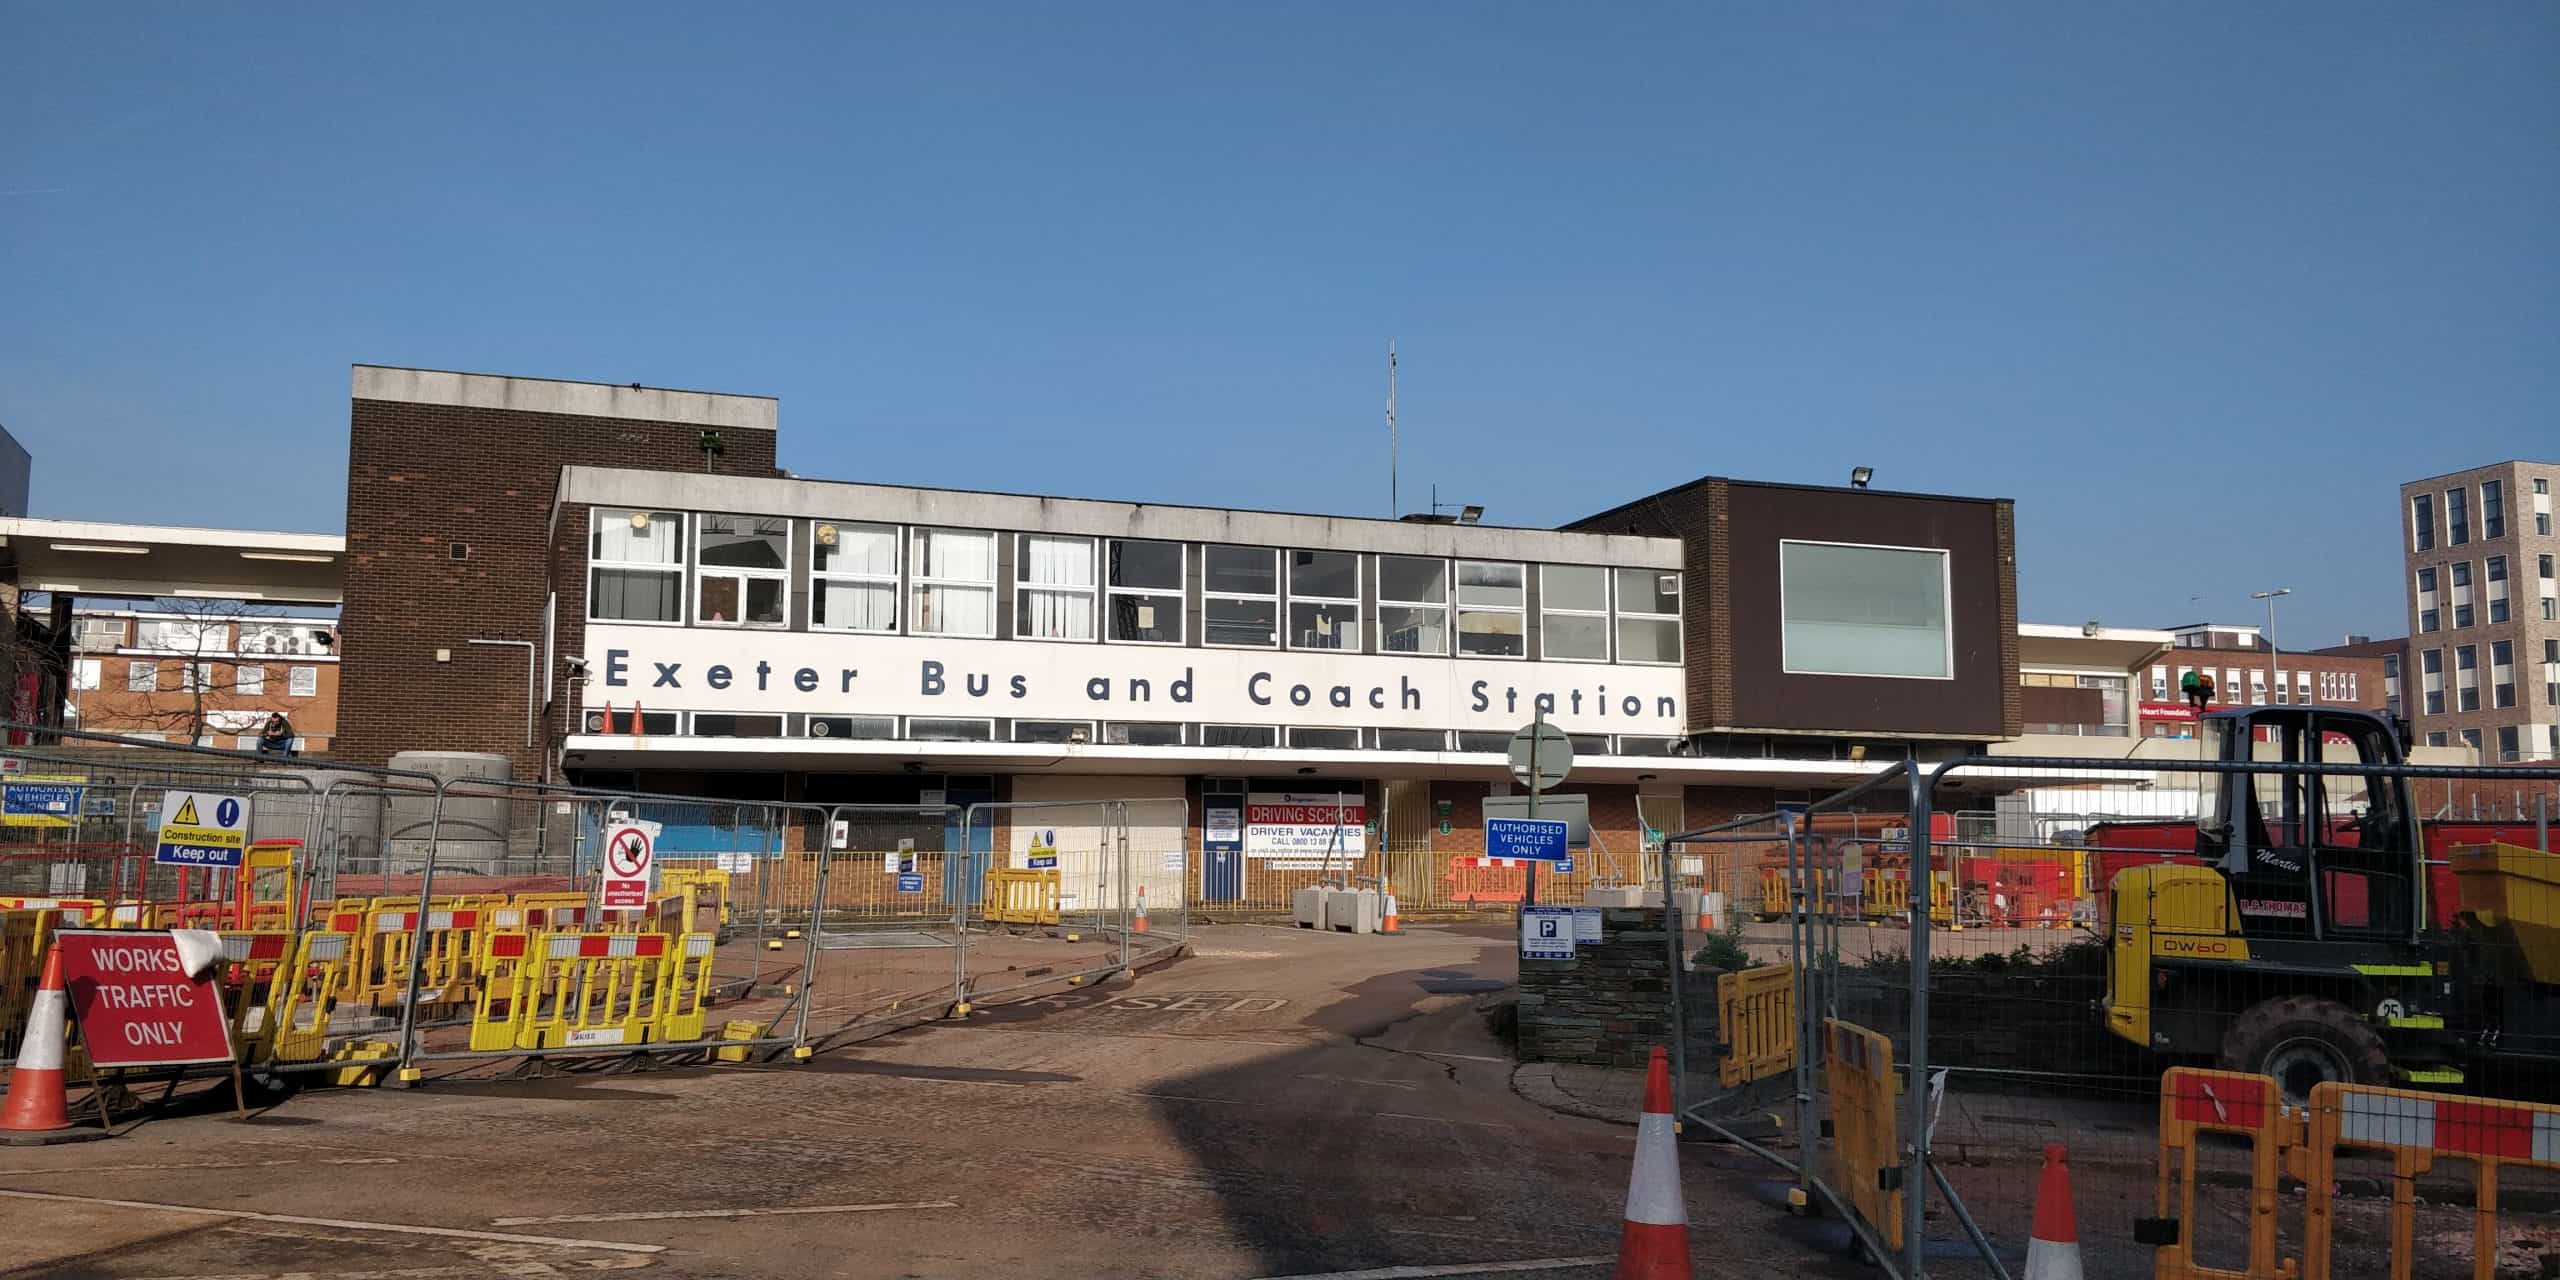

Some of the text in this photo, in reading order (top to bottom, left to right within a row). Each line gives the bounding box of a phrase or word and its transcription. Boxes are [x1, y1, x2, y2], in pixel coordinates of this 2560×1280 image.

[605, 649, 1676, 718] Exeter Bus and Coach Station
[2142, 707, 2159, 716] Heart
[17, 793, 70, 802] VEHICLES
[1251, 806, 1304, 823] DRIVING
[164, 829, 241, 844] Construction site
[1250, 827, 1294, 836] DRIVER
[1491, 823, 1563, 835] AUTHORISED
[1272, 837, 1290, 846] CALL
[1500, 833, 1554, 845] VEHICLES
[172, 845, 228, 862] Keep out
[1511, 845, 1541, 855] ONLY
[2256, 848, 2301, 872] Martin
[2163, 939, 2227, 953] DW60
[91, 948, 180, 973] WORKS
[95, 984, 194, 1009] TRAFFIC
[2383, 1003, 2399, 1019] 25
[124, 1021, 184, 1046] ONLY
